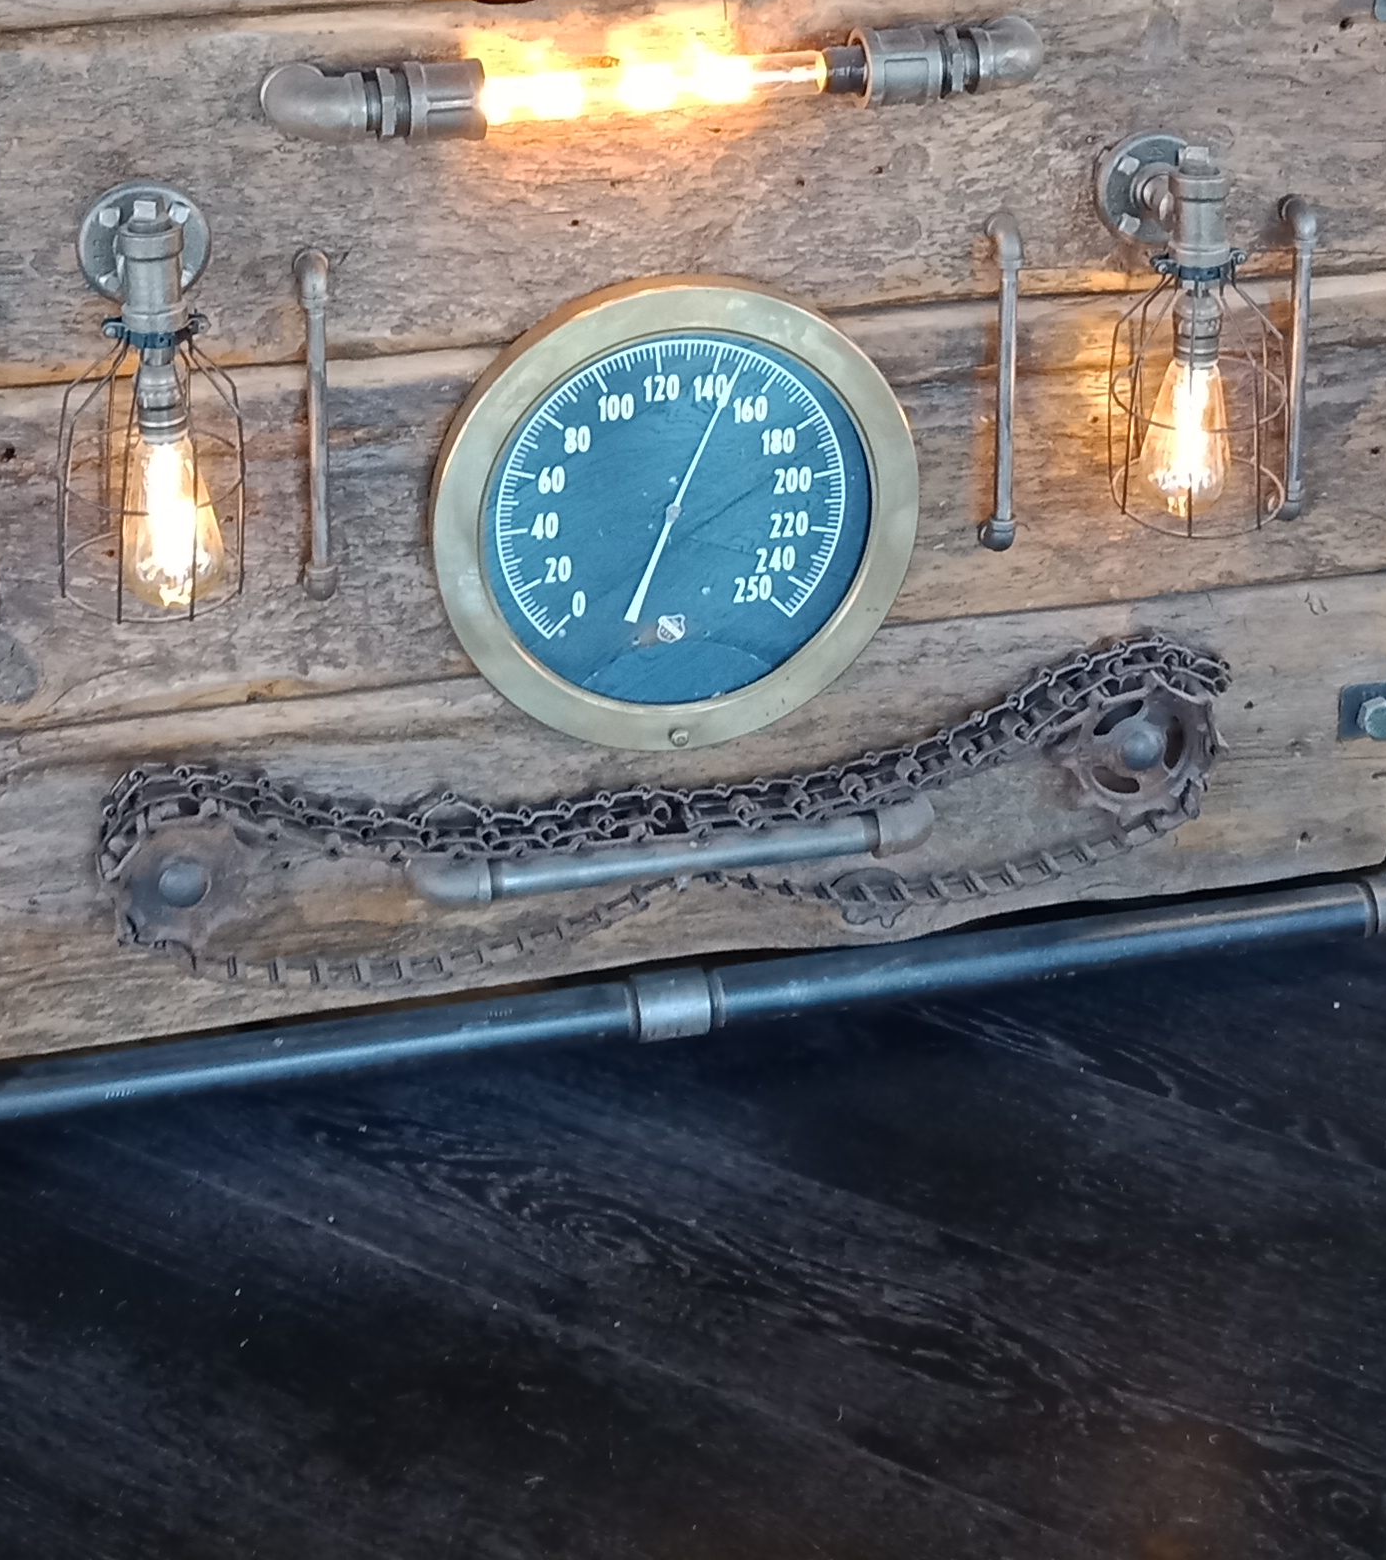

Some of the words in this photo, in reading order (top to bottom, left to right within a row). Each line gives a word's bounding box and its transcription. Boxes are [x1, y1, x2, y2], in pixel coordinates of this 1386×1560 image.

[643, 375, 680, 401] 120
[693, 374, 728, 401] 140
[598, 394, 635, 422] 100
[733, 395, 768, 422] 160
[564, 425, 591, 453] 80
[761, 427, 796, 454] 180
[537, 465, 565, 493] 60
[773, 466, 812, 494] 200
[530, 512, 559, 539] 40
[770, 511, 809, 538] 220
[544, 556, 571, 583] 20
[756, 545, 795, 573] 240
[733, 576, 772, 603] 250
[571, 590, 586, 618] 0
